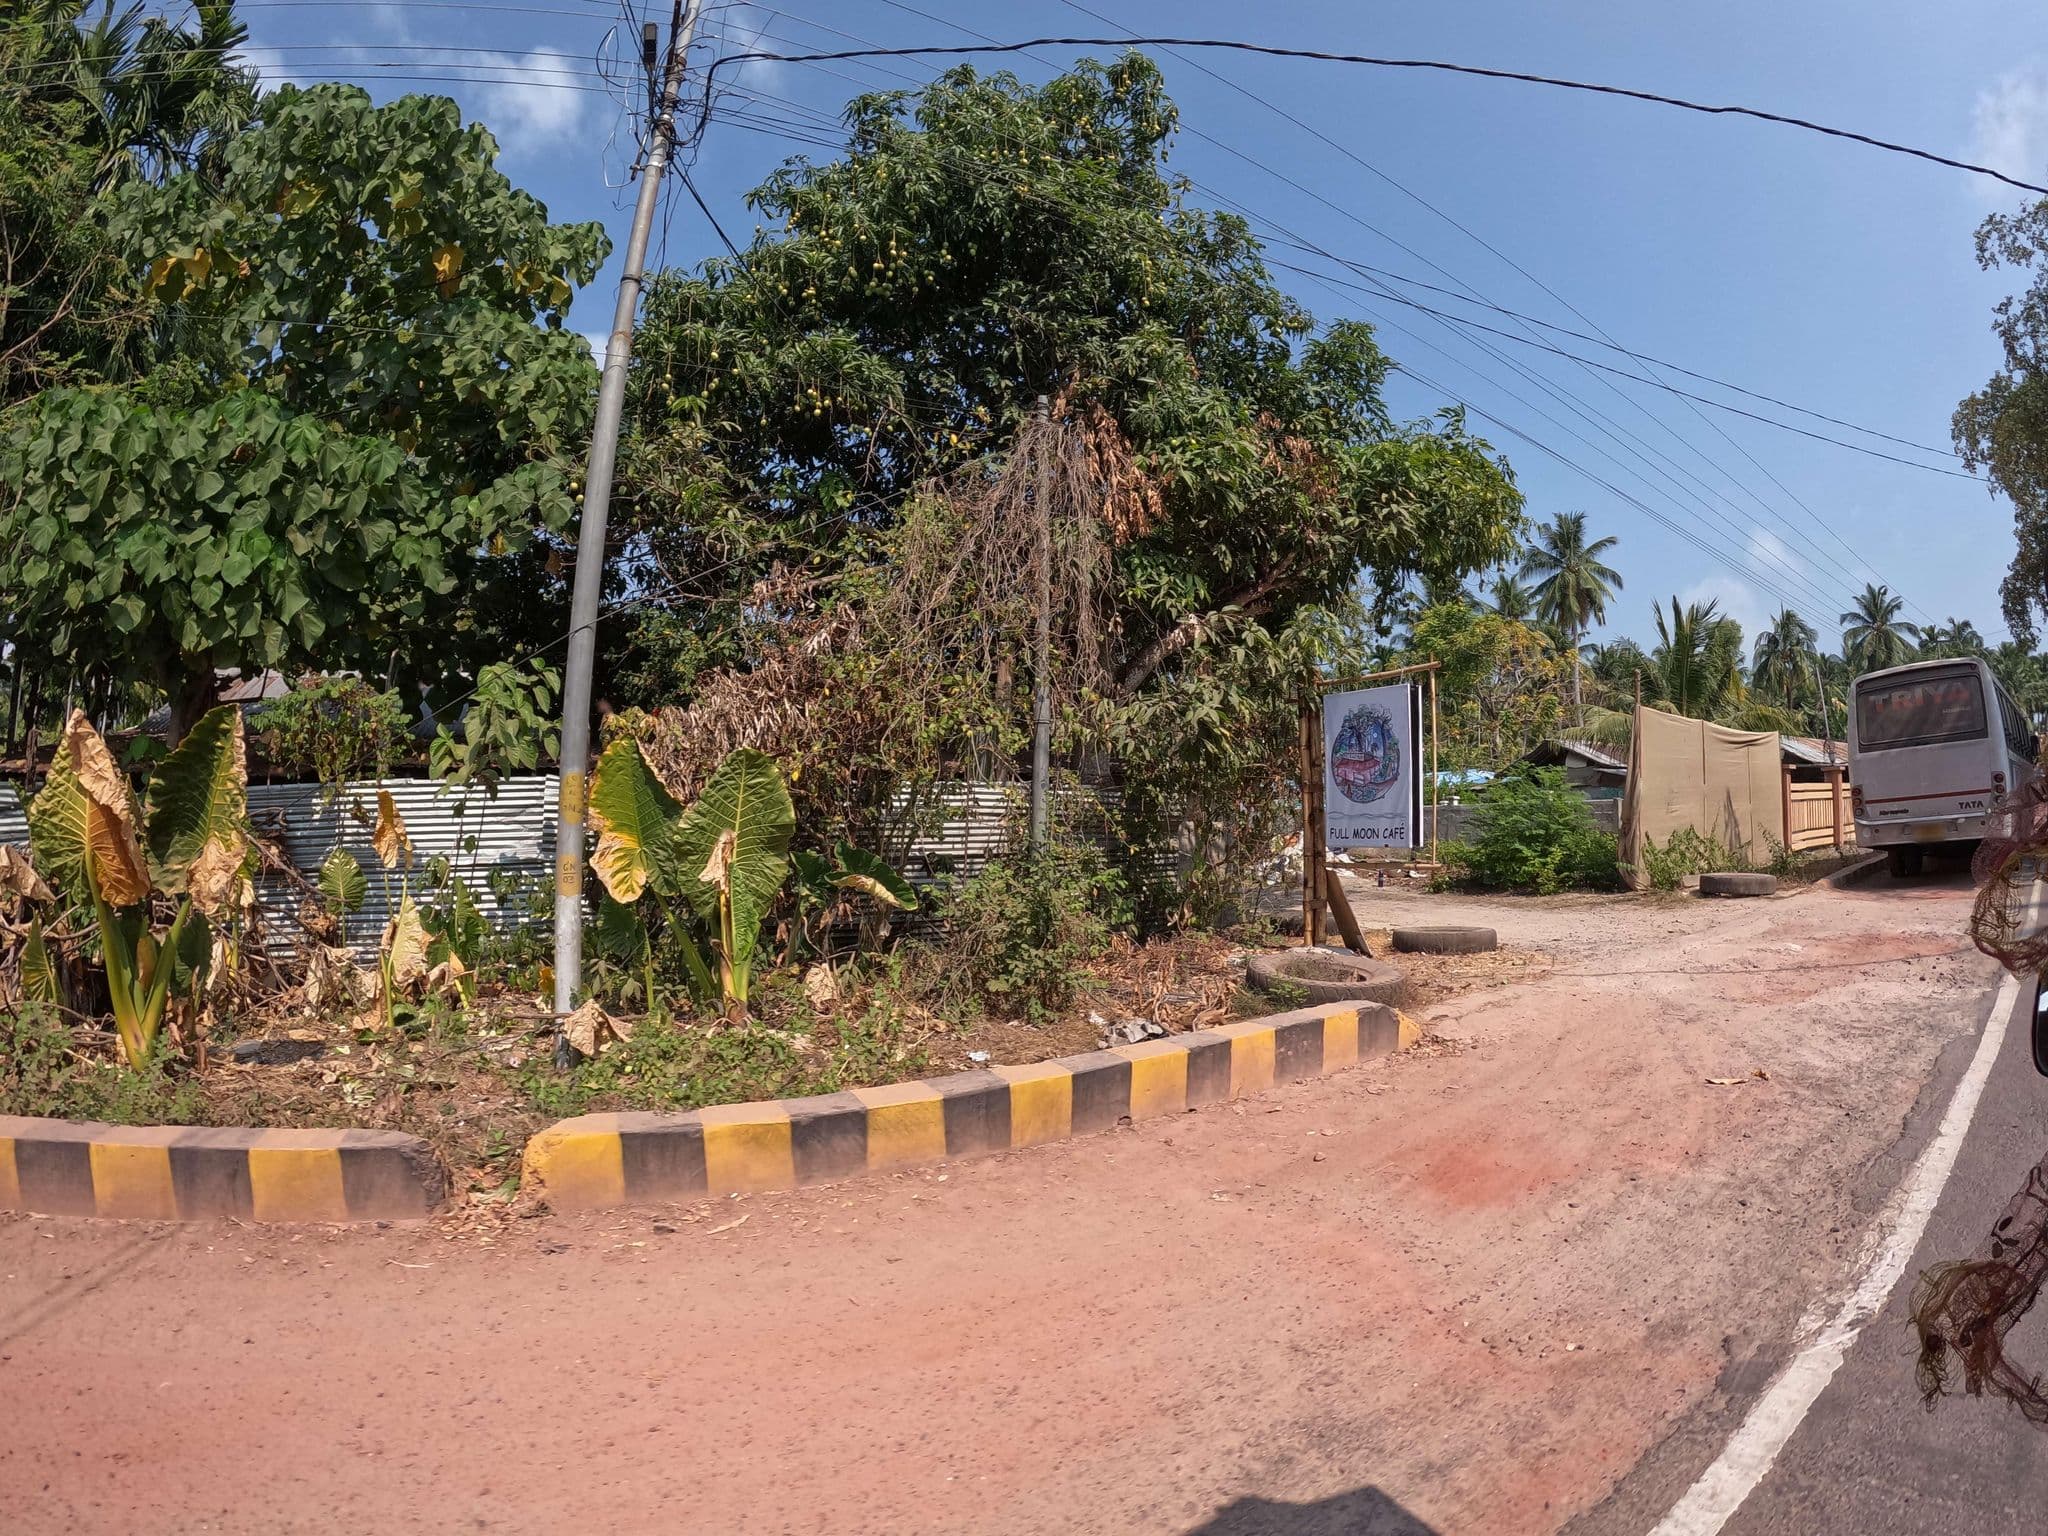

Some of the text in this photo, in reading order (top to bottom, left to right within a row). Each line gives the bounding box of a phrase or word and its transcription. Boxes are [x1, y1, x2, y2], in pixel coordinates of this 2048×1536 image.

[1958, 800, 1984, 810] TATA
[1329, 822, 1405, 840] FULL MOON CAFÉ
